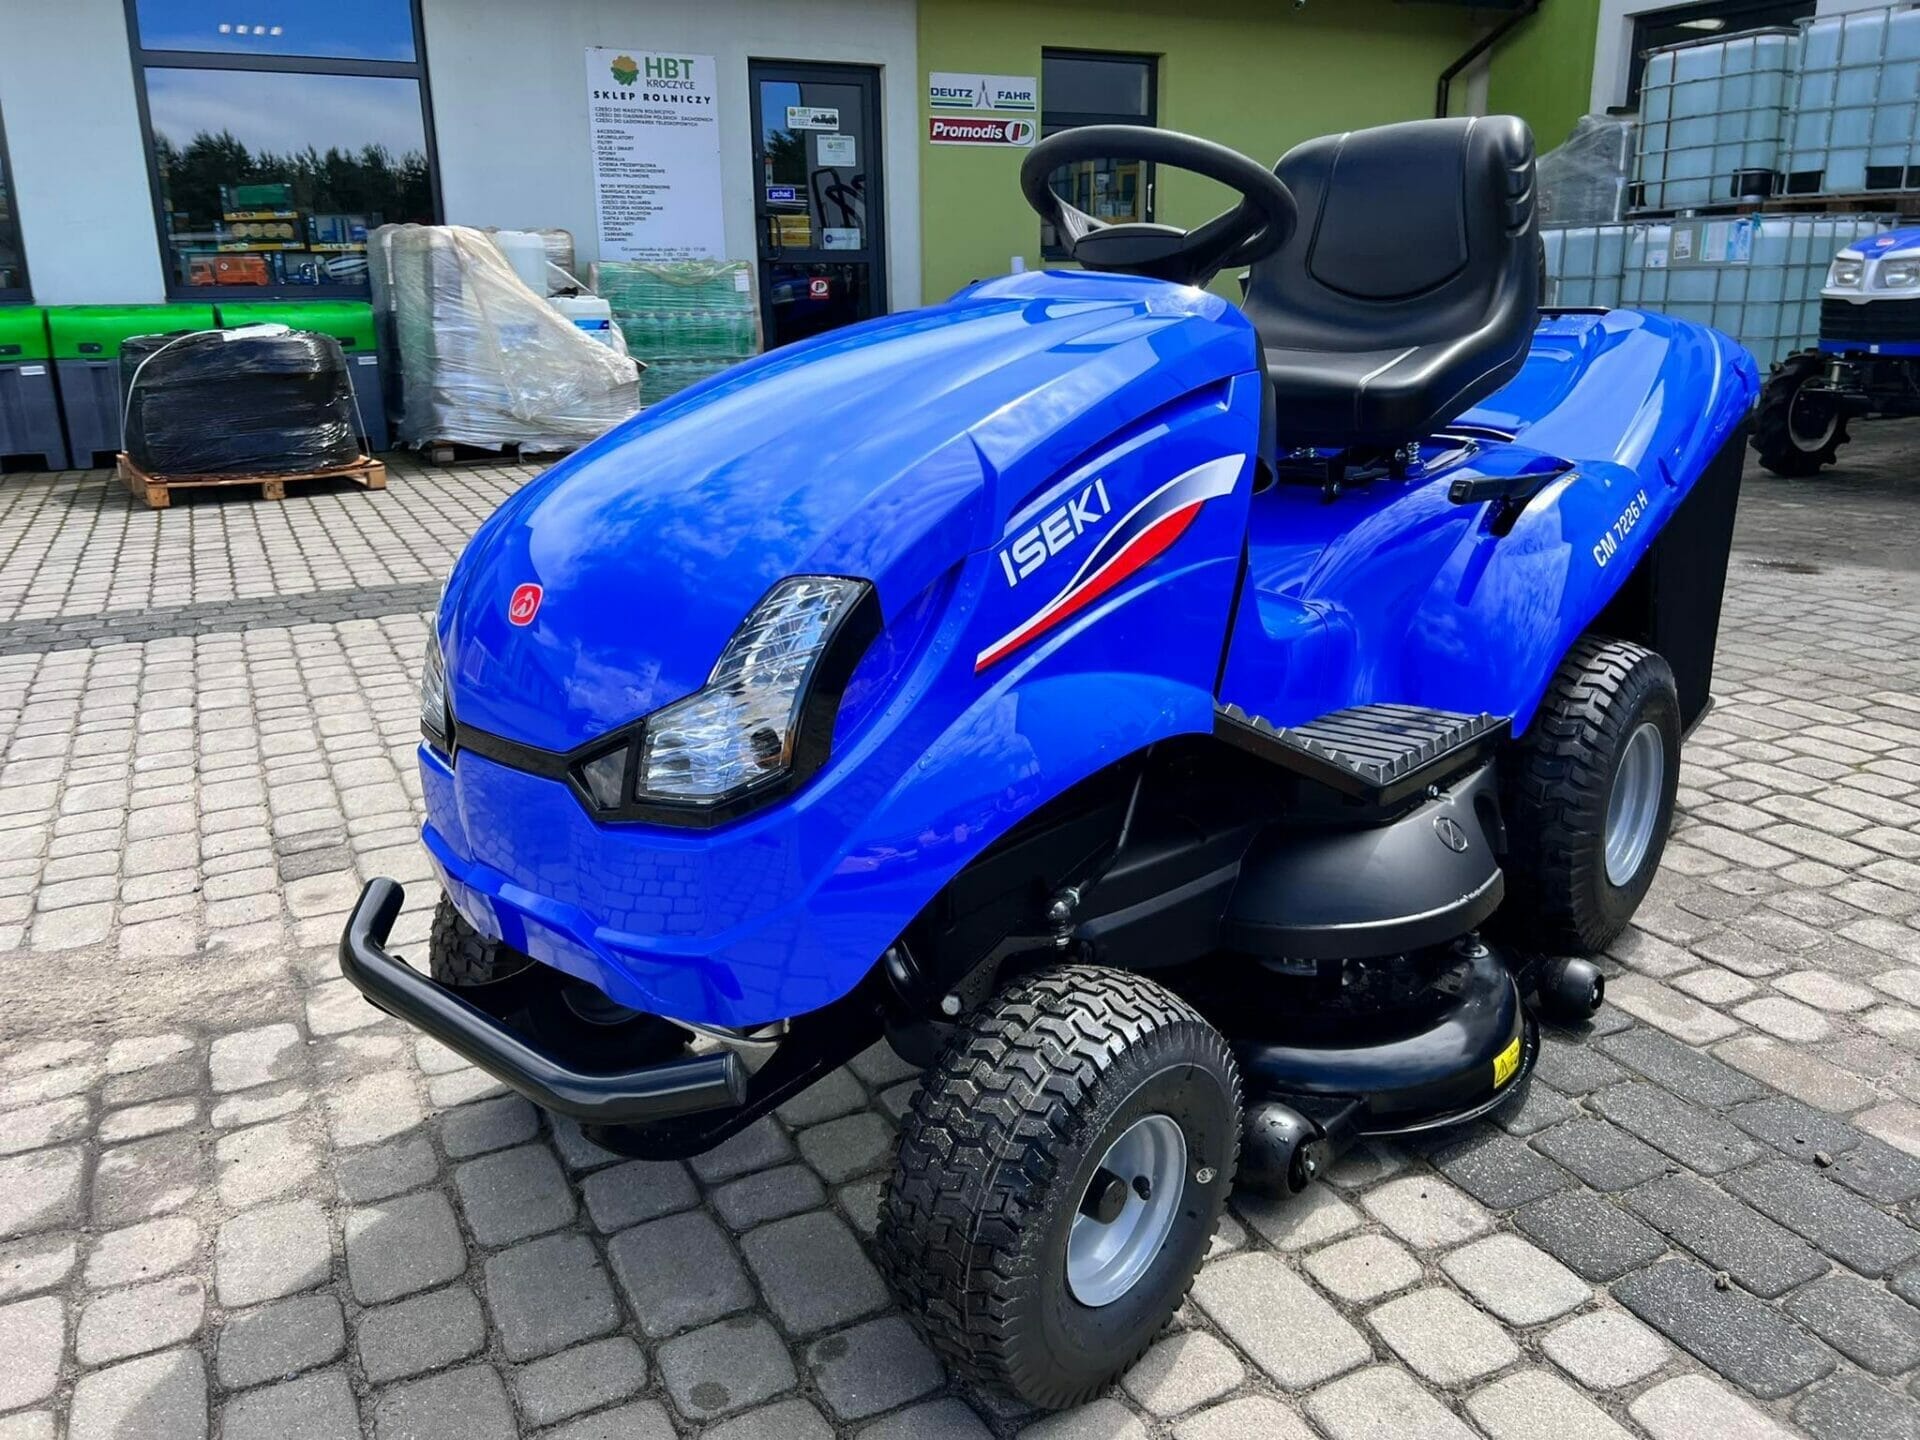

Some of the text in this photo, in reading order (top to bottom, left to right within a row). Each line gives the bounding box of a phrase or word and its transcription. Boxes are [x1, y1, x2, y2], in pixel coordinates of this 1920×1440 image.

[645, 56, 694, 80] HBT
[647, 79, 695, 90] KROCZYCE
[594, 90, 711, 104] SKLEP ROLNICZY
[931, 87, 1031, 101] DEUTZ FAHR
[932, 122, 1003, 139] Promodis
[1000, 478, 1111, 588] ISEKI
[1592, 489, 1648, 567] CM 7226 H
